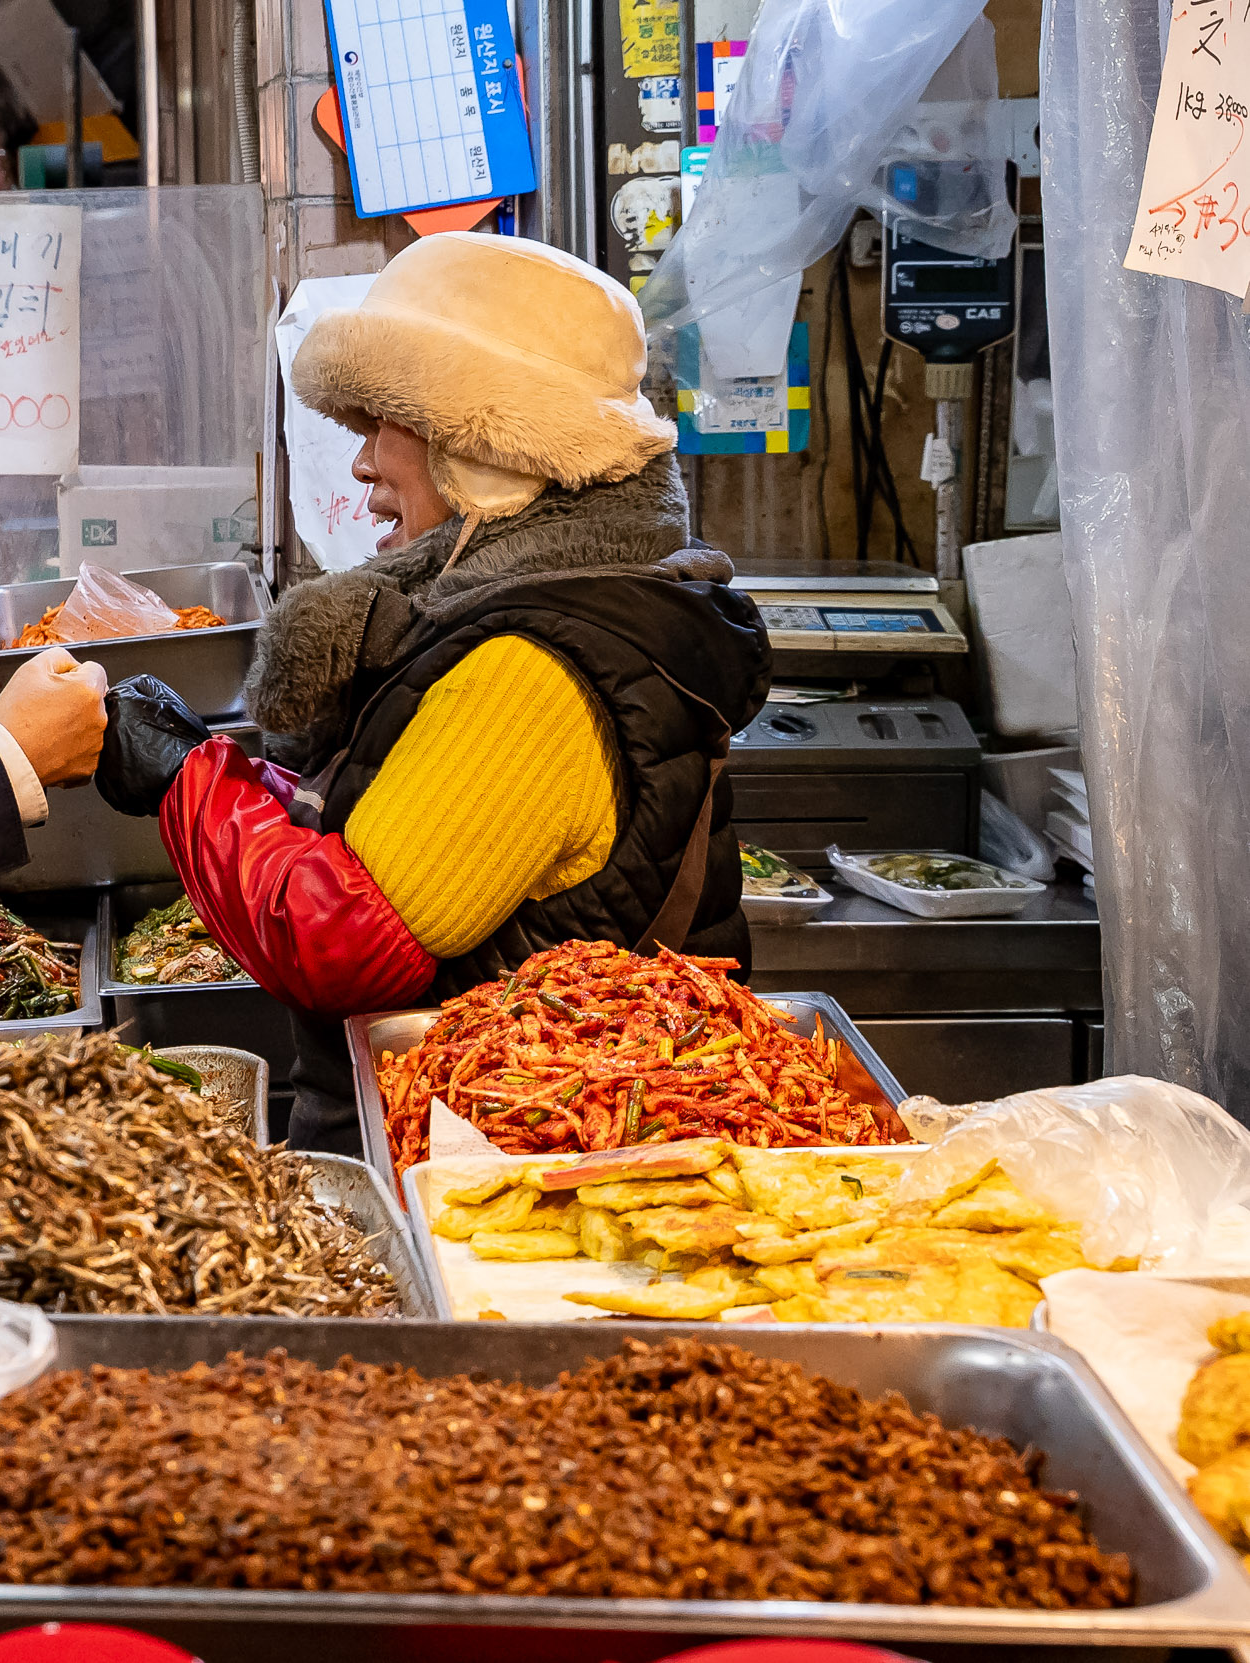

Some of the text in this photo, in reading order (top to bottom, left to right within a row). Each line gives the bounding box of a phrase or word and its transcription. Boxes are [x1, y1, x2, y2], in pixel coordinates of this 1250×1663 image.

[450, 23, 467, 59] 원산지
[473, 22, 506, 116] 원산지 표시
[1175, 82, 1207, 120] 1kg
[469, 145, 487, 181] 원산지
[965, 307, 1001, 319] CAS
